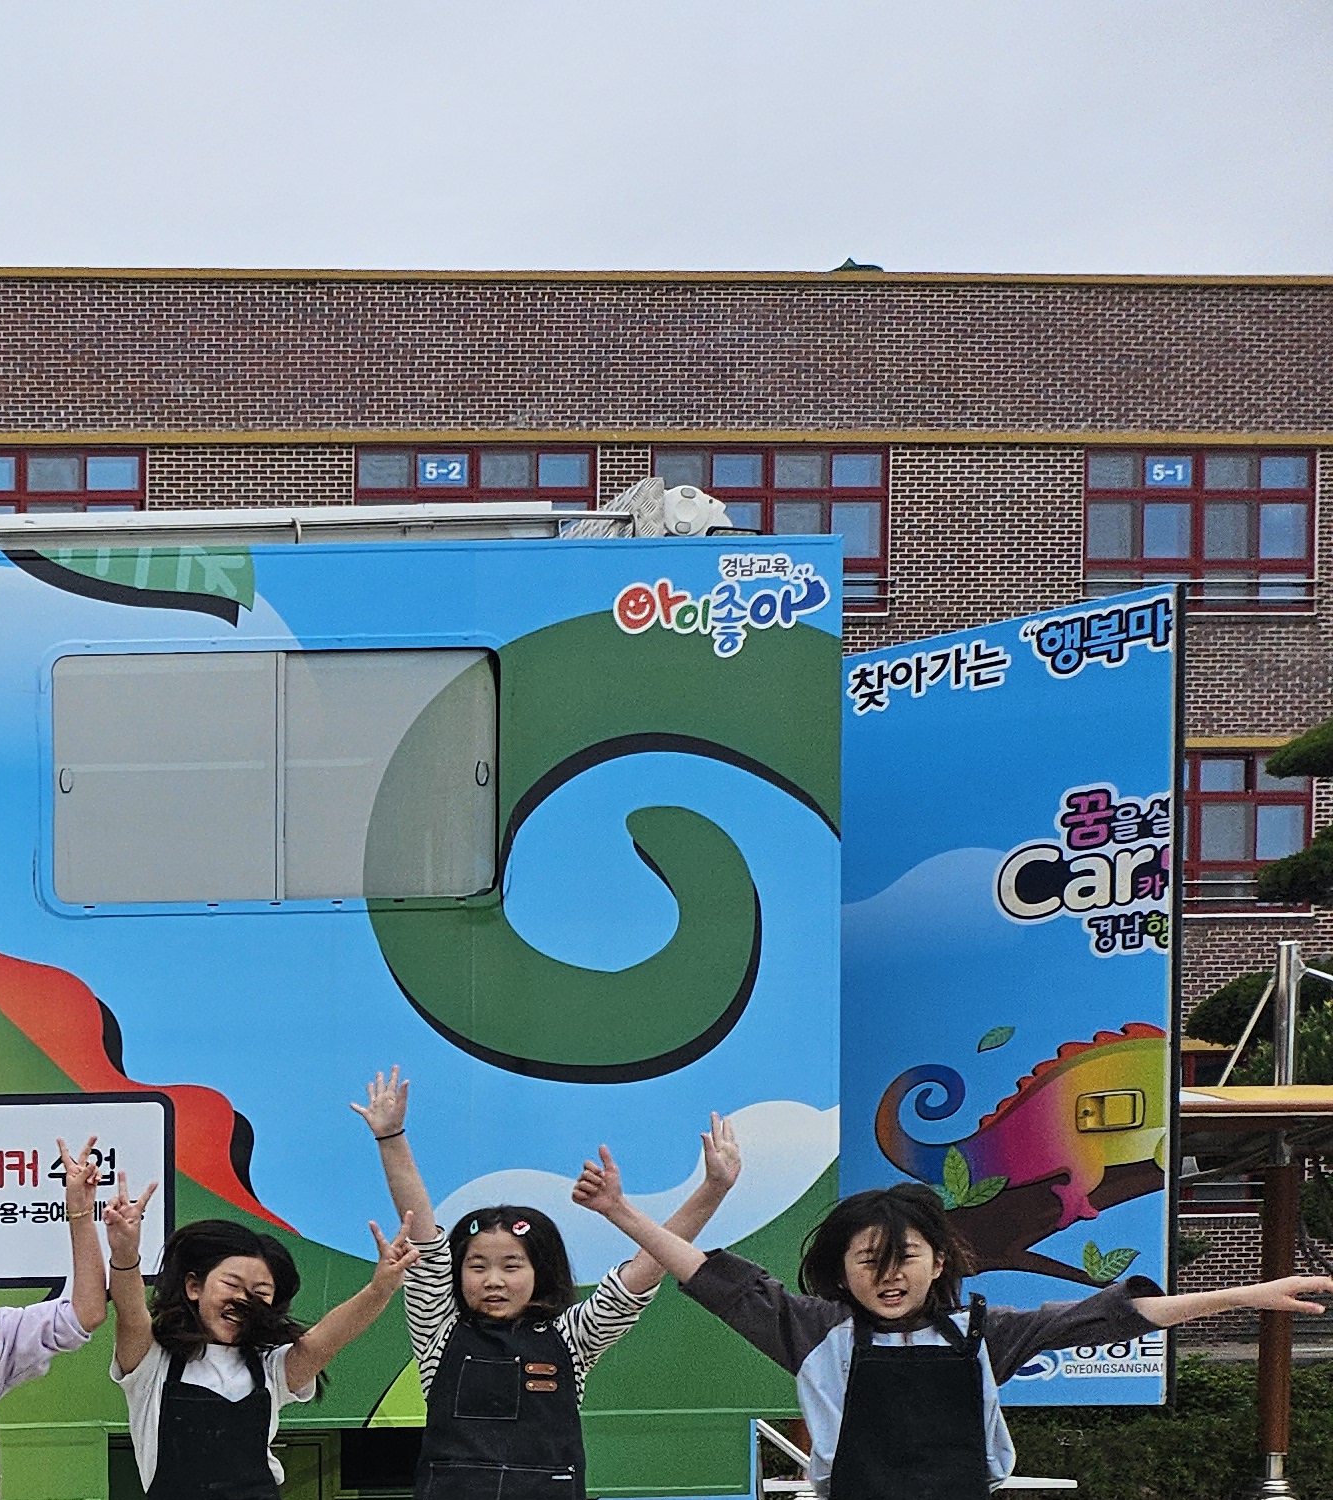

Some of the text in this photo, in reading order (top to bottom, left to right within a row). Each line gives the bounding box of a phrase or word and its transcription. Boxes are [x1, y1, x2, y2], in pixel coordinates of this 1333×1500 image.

[425, 461, 462, 480] 5-2
[1152, 463, 1184, 481] 5-1
[722, 557, 789, 578] 경남교육
[850, 643, 1007, 712] 찾아가는
[1064, 792, 1142, 847] 꿈을
[1000, 847, 1155, 917] Car
[1065, 1363, 1163, 1375] GYEONGSANGNA
